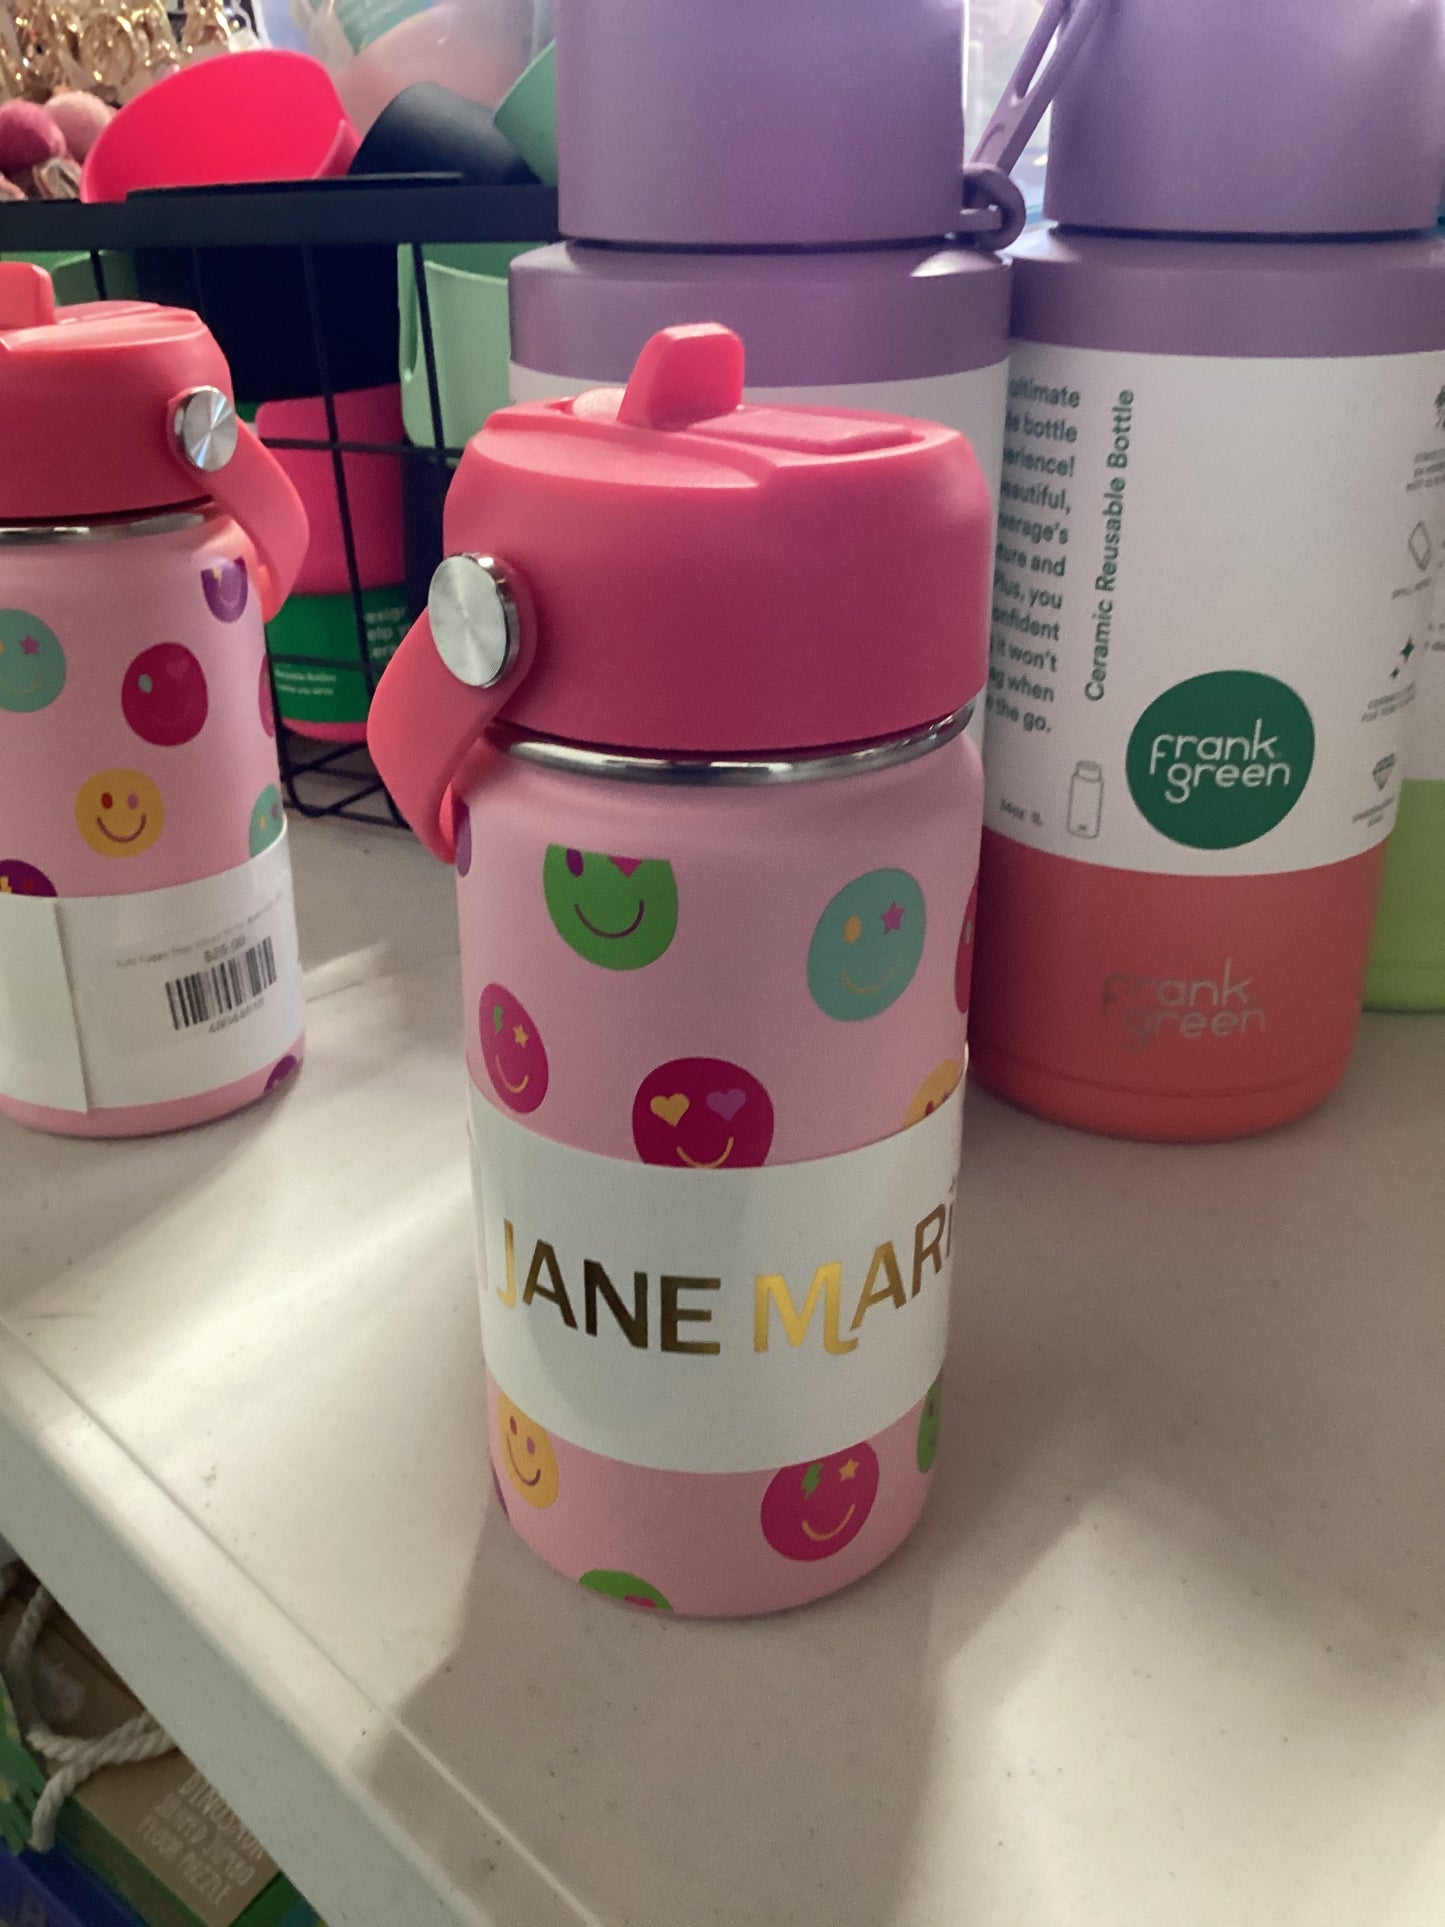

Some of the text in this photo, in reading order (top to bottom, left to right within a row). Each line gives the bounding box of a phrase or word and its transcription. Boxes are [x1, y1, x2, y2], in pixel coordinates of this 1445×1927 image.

[1024, 412, 1077, 443] bottle
[1003, 446, 1074, 478] erience!
[998, 513, 1068, 544] verage's
[1085, 389, 1134, 701] Ceramic Reusable Bottle
[1031, 555, 1067, 576] and
[1029, 588, 1062, 609] you
[993, 607, 1059, 641] onfident
[1008, 645, 1056, 672] won't
[1008, 674, 1054, 702] when
[1023, 711, 1052, 733] go.
[1149, 717, 1279, 775] frank
[1164, 762, 1291, 804] green
[1102, 957, 1252, 1017] frank
[1120, 1009, 1267, 1055] green
[496, 1217, 721, 1355] JANE
